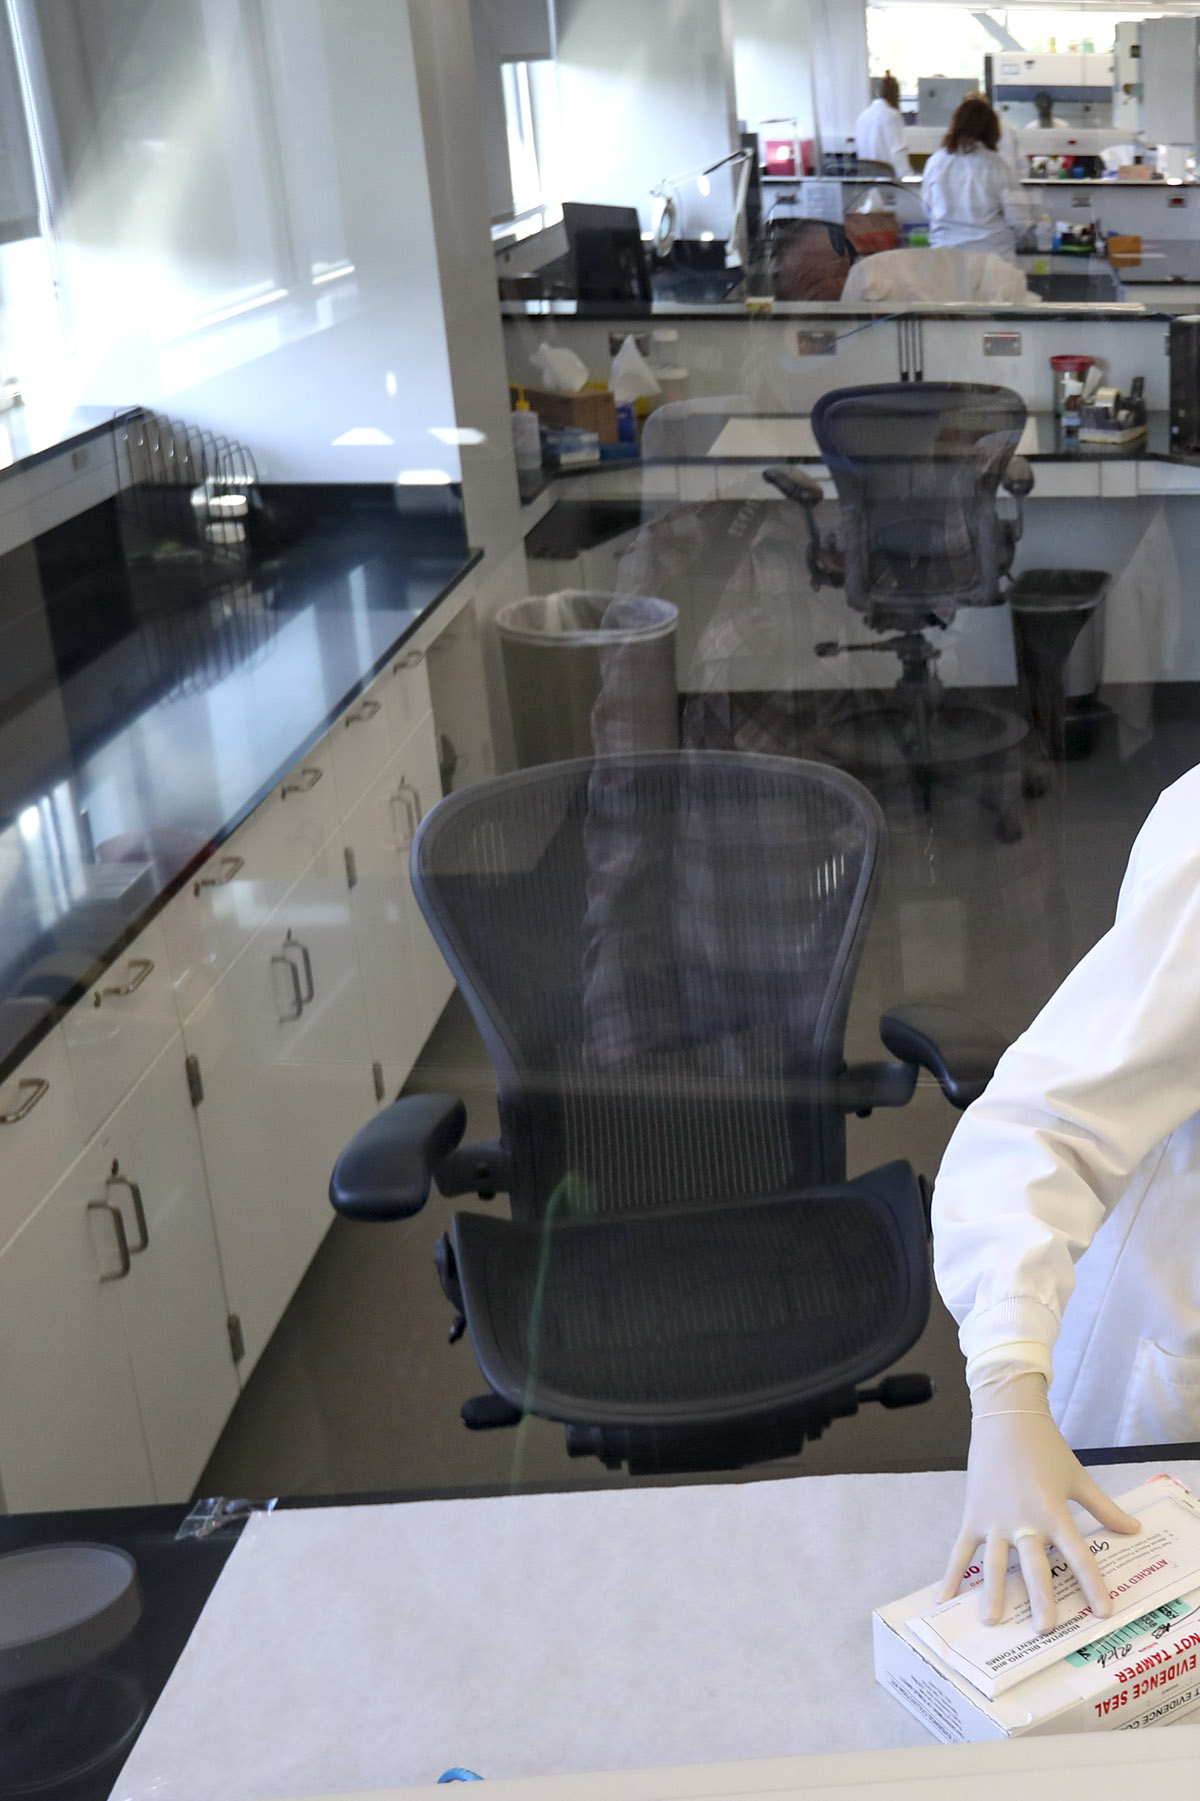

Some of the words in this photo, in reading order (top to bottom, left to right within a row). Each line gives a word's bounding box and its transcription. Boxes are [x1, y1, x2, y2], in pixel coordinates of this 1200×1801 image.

[1128, 1559, 1169, 1584] ATTACHED
[1117, 1583, 1130, 1593] TO
[1042, 1624, 1081, 1646] HOSPITAL
[1173, 1632, 1200, 1655] NOT
[985, 1649, 1016, 1667] FORMS
[1008, 1644, 1041, 1662] BILLING
[992, 1661, 1008, 1672] and
[1114, 1649, 1172, 1683] TAMPER
[1133, 1654, 1197, 1699] EVIDENCE
[1094, 1690, 1128, 1718] SEAL
[1142, 1691, 1192, 1725] EVIDENCE
